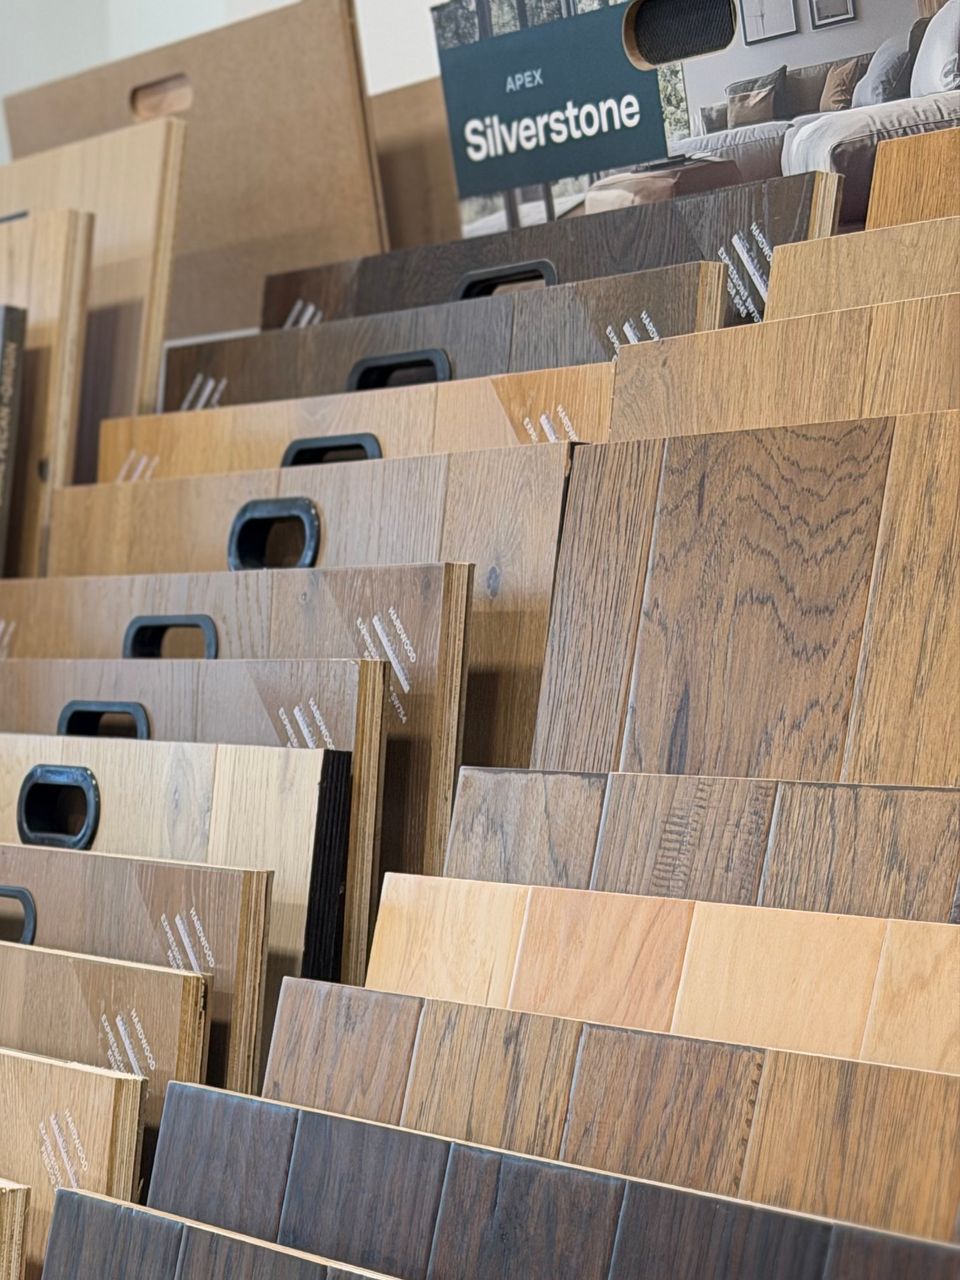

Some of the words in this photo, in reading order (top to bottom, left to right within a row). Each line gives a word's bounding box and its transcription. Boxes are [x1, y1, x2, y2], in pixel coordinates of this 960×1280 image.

[506, 68, 543, 92] APEX
[464, 94, 640, 162] Silverstone
[388, 606, 417, 663] HARDWOOD
[190, 907, 215, 968] HARDWOOD
[131, 1008, 156, 1071] HARDWOOD
[65, 1108, 88, 1172] HARDWOOD
